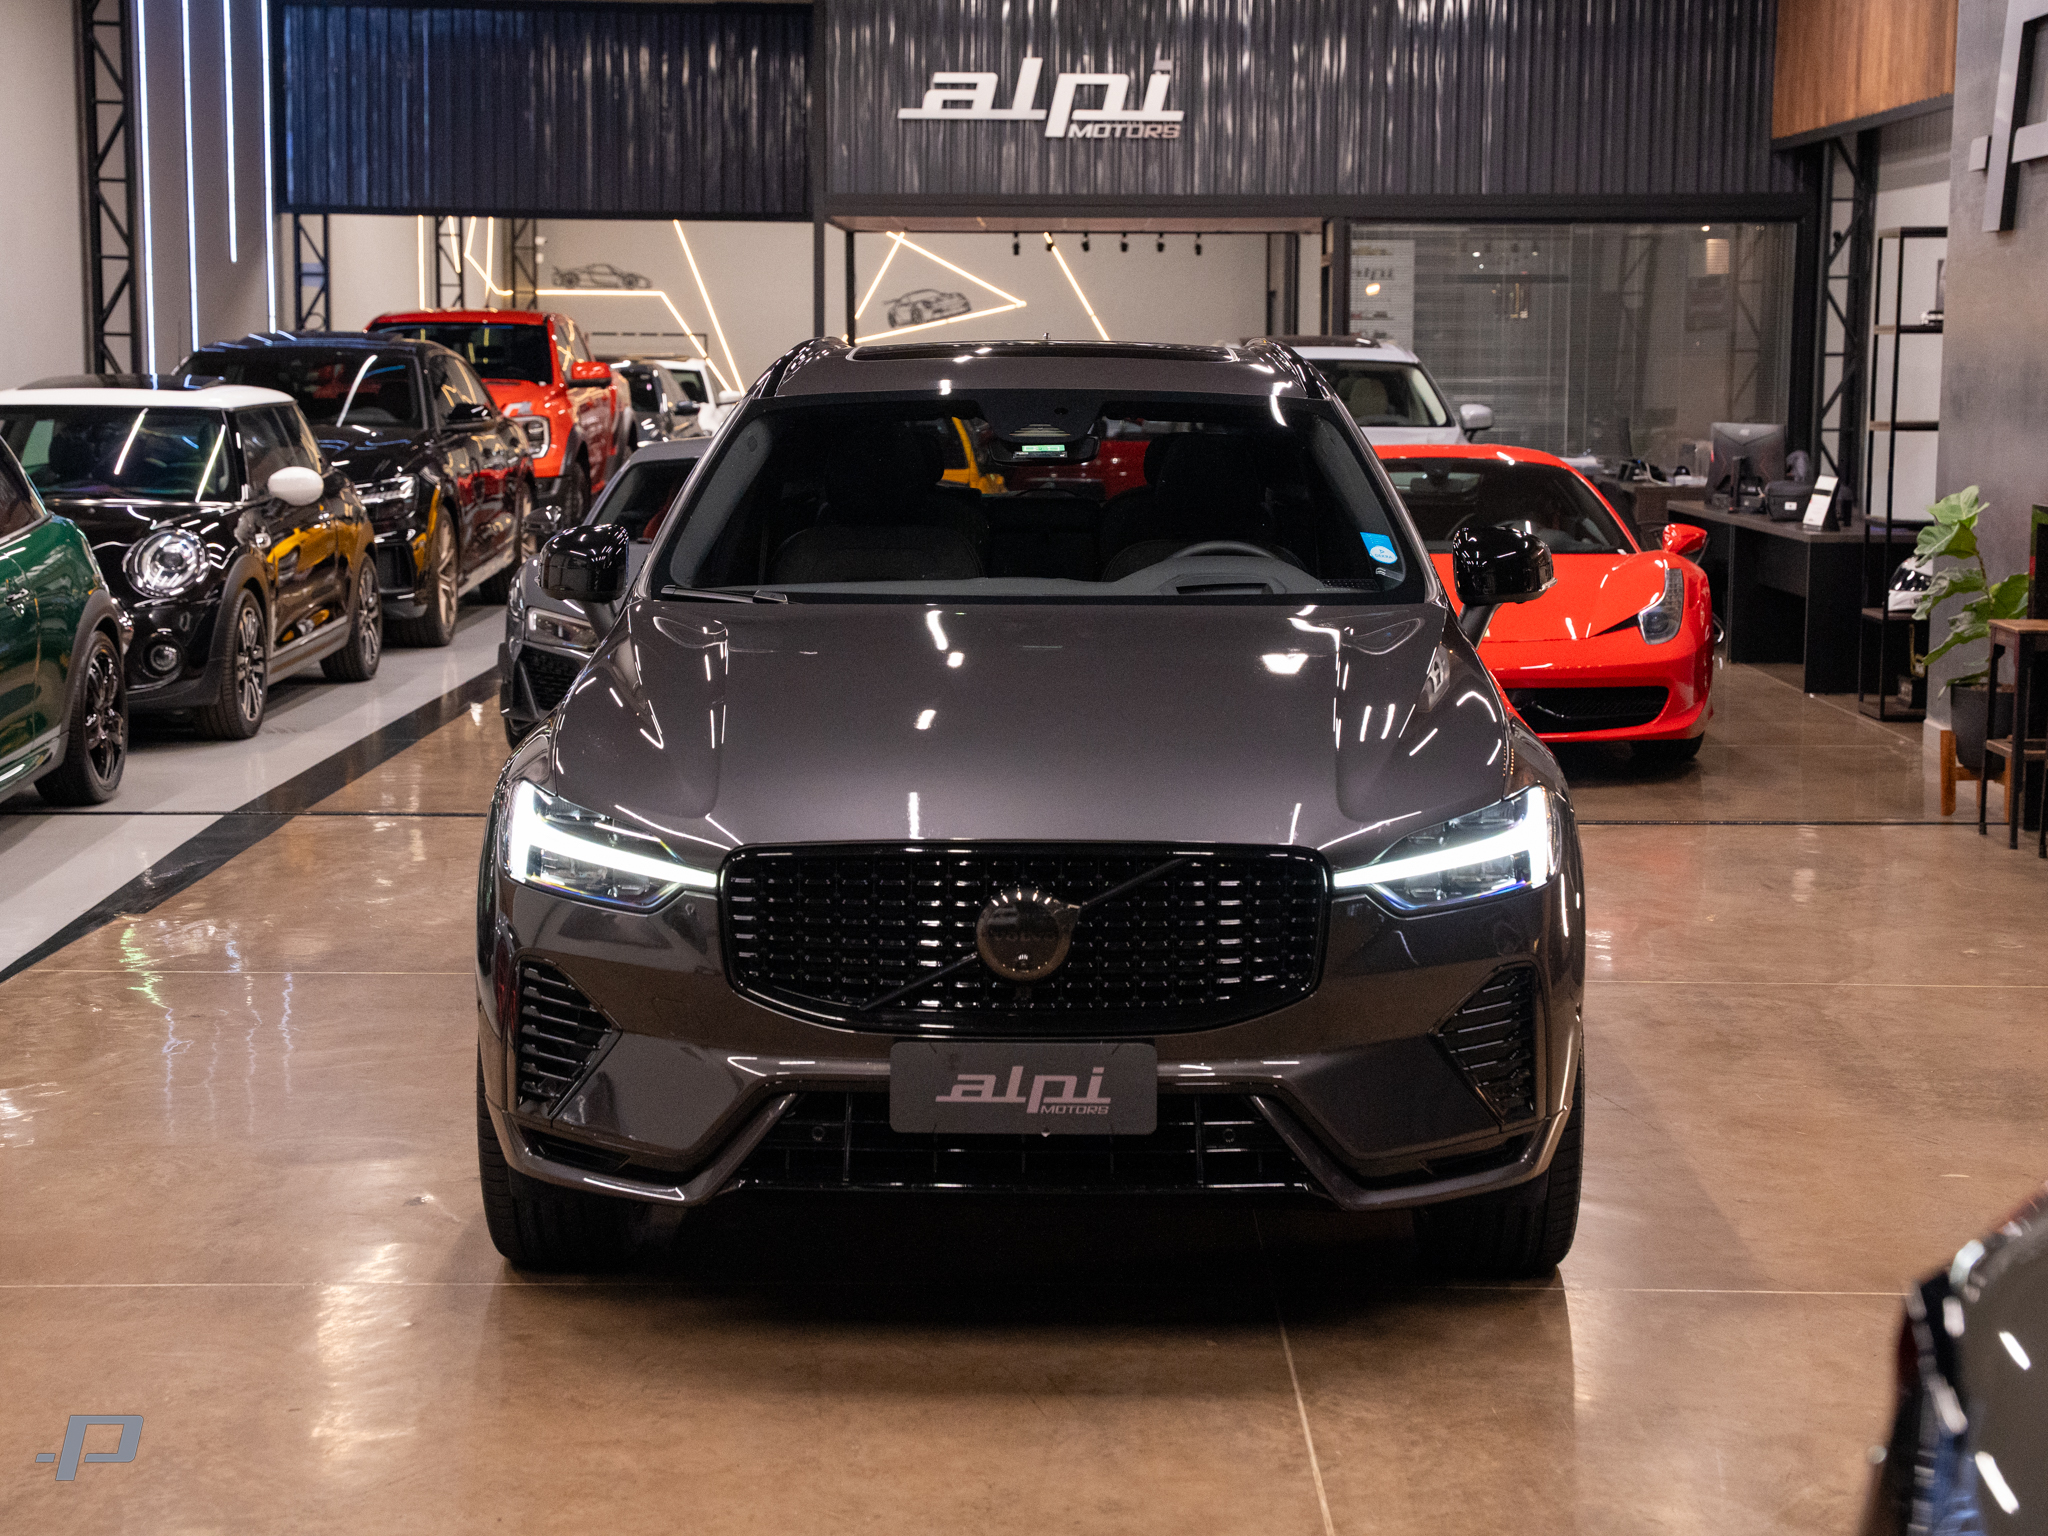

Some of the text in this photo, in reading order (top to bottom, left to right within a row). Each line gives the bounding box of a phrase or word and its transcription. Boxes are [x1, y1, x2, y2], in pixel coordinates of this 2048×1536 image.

[897, 57, 1185, 138] alpi
[1067, 123, 1182, 138] MOTORS
[935, 1065, 1111, 1114] alpi
[1040, 1105, 1109, 1115] MOTORS
